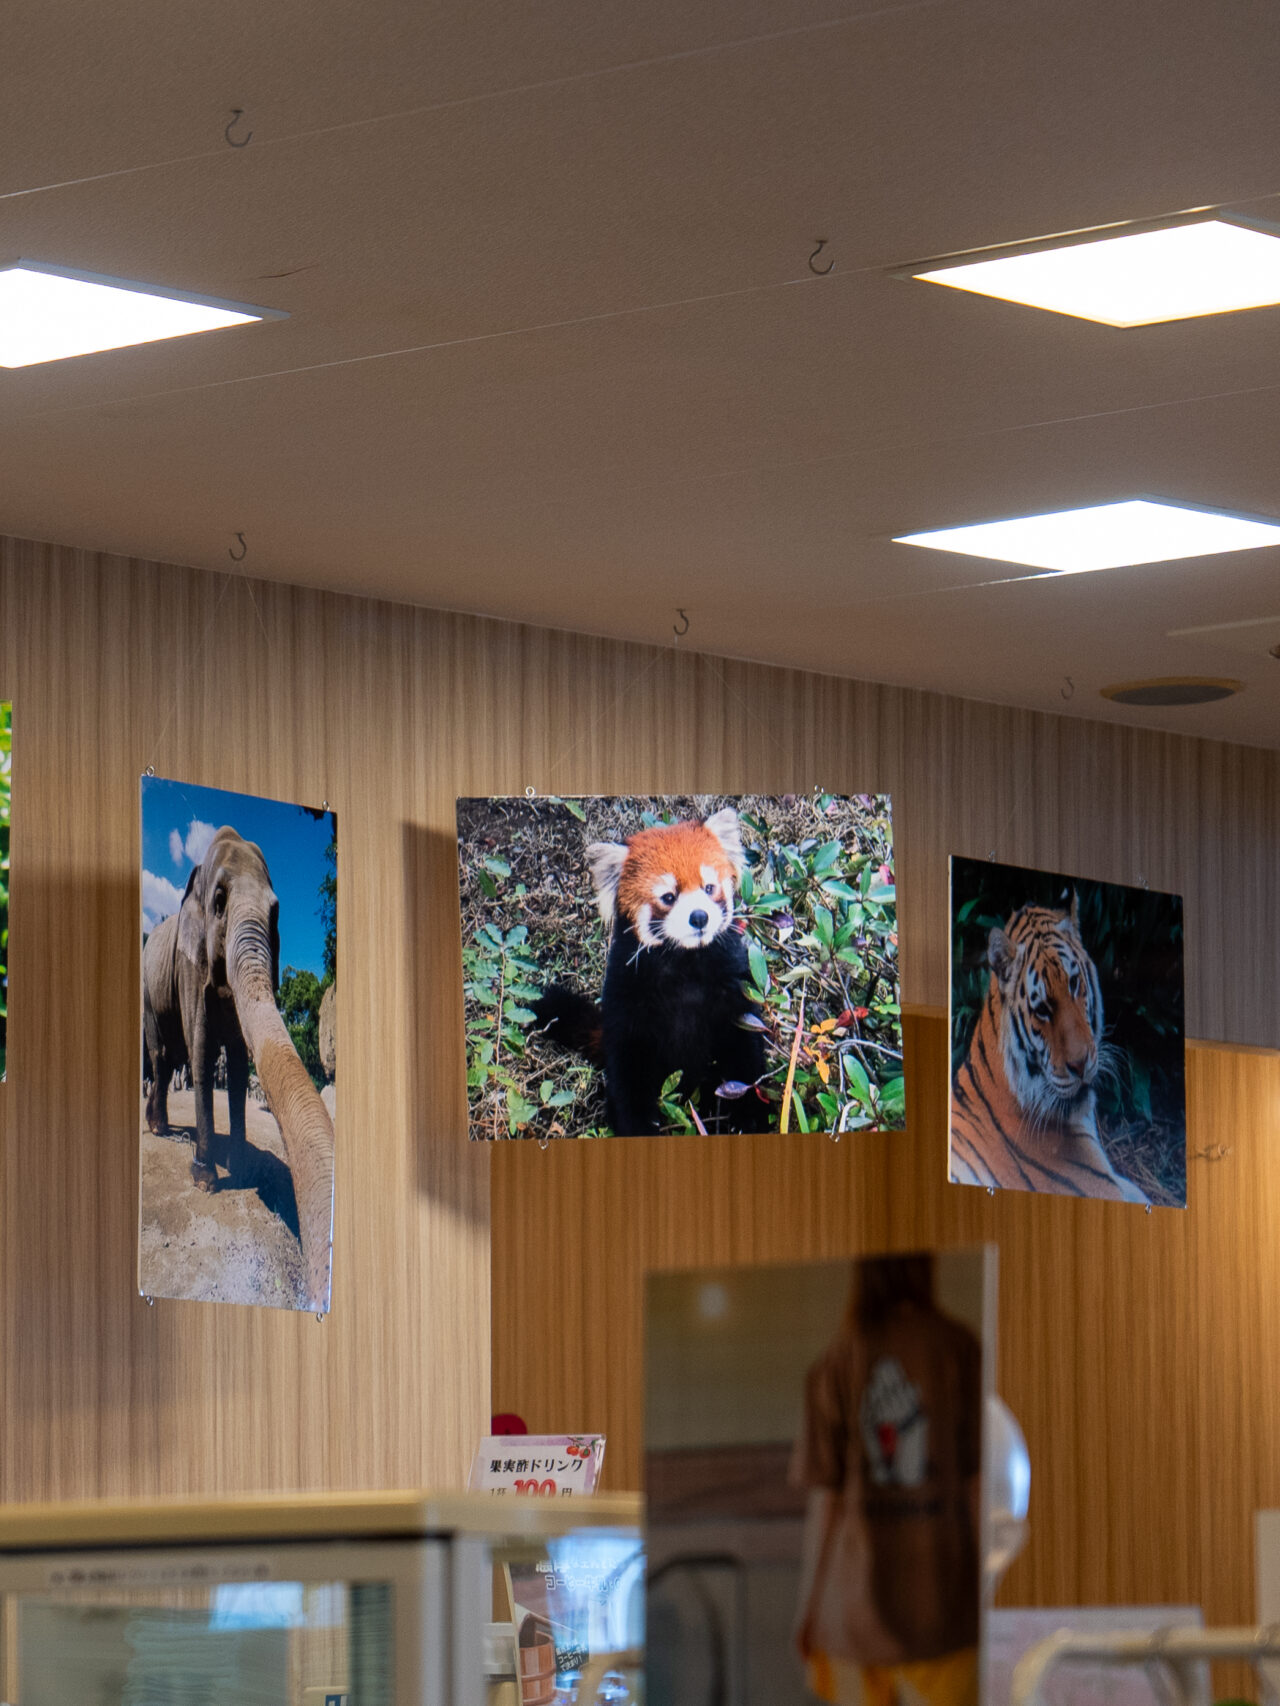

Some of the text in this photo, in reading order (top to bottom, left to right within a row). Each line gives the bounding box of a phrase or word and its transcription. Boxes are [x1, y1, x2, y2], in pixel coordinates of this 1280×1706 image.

[489, 1459, 583, 1473] 果実酢ドリンク
[513, 1478, 556, 1498] 100
